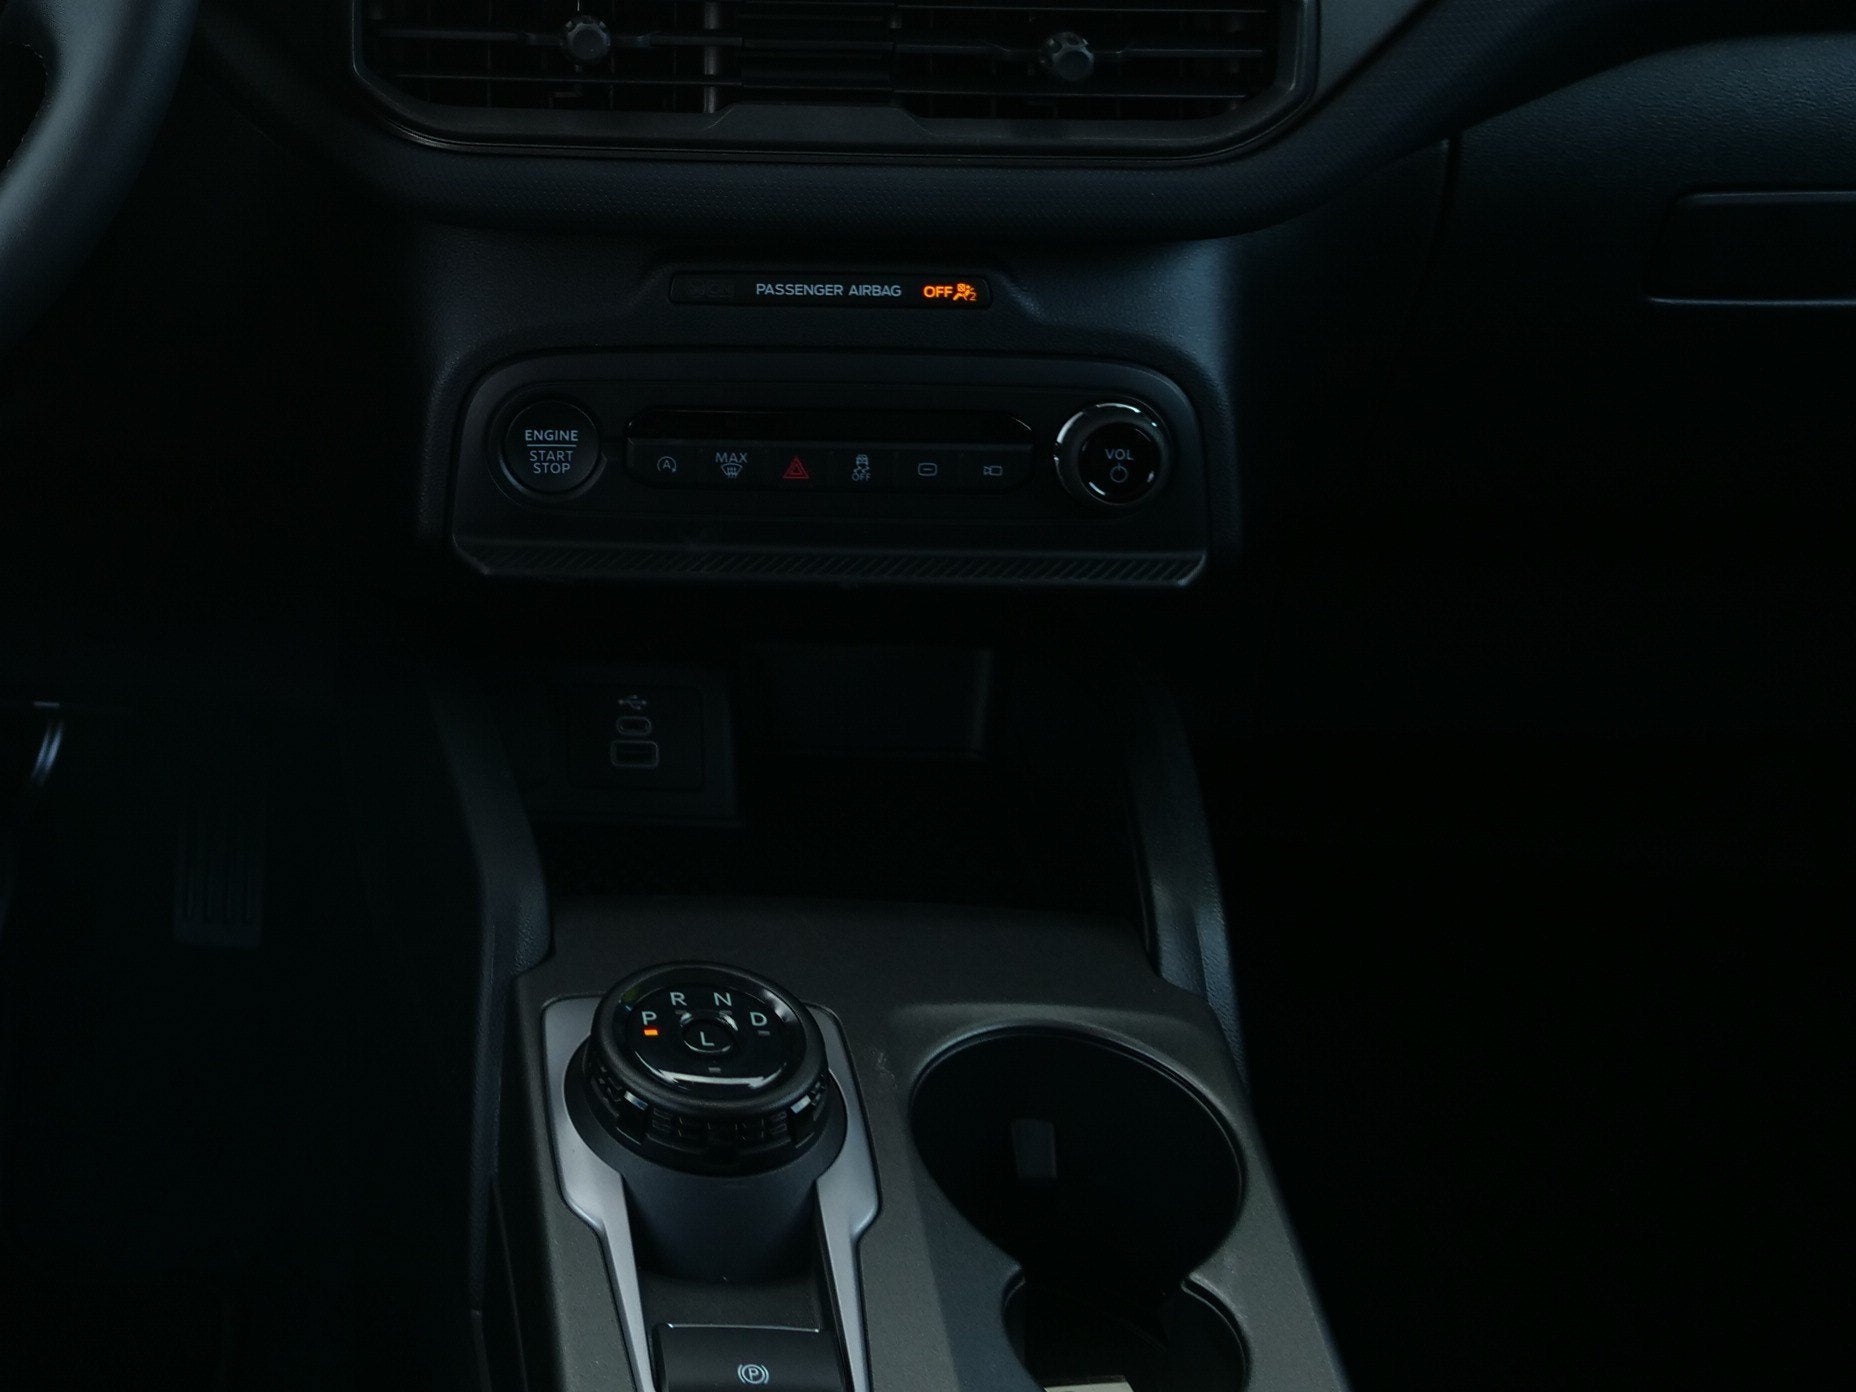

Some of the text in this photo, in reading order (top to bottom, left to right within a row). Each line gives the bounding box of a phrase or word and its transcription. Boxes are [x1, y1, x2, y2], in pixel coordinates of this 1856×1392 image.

[756, 283, 954, 299] PASSENGER AIRBAG OFF
[524, 429, 579, 442] ENGINE
[529, 450, 574, 462] START
[715, 451, 748, 463] MAX
[1104, 448, 1135, 460] VOL
[533, 462, 571, 474] STOP
[851, 473, 872, 482] OFF
[641, 991, 768, 1027] P R N D
[699, 1030, 715, 1047] L
